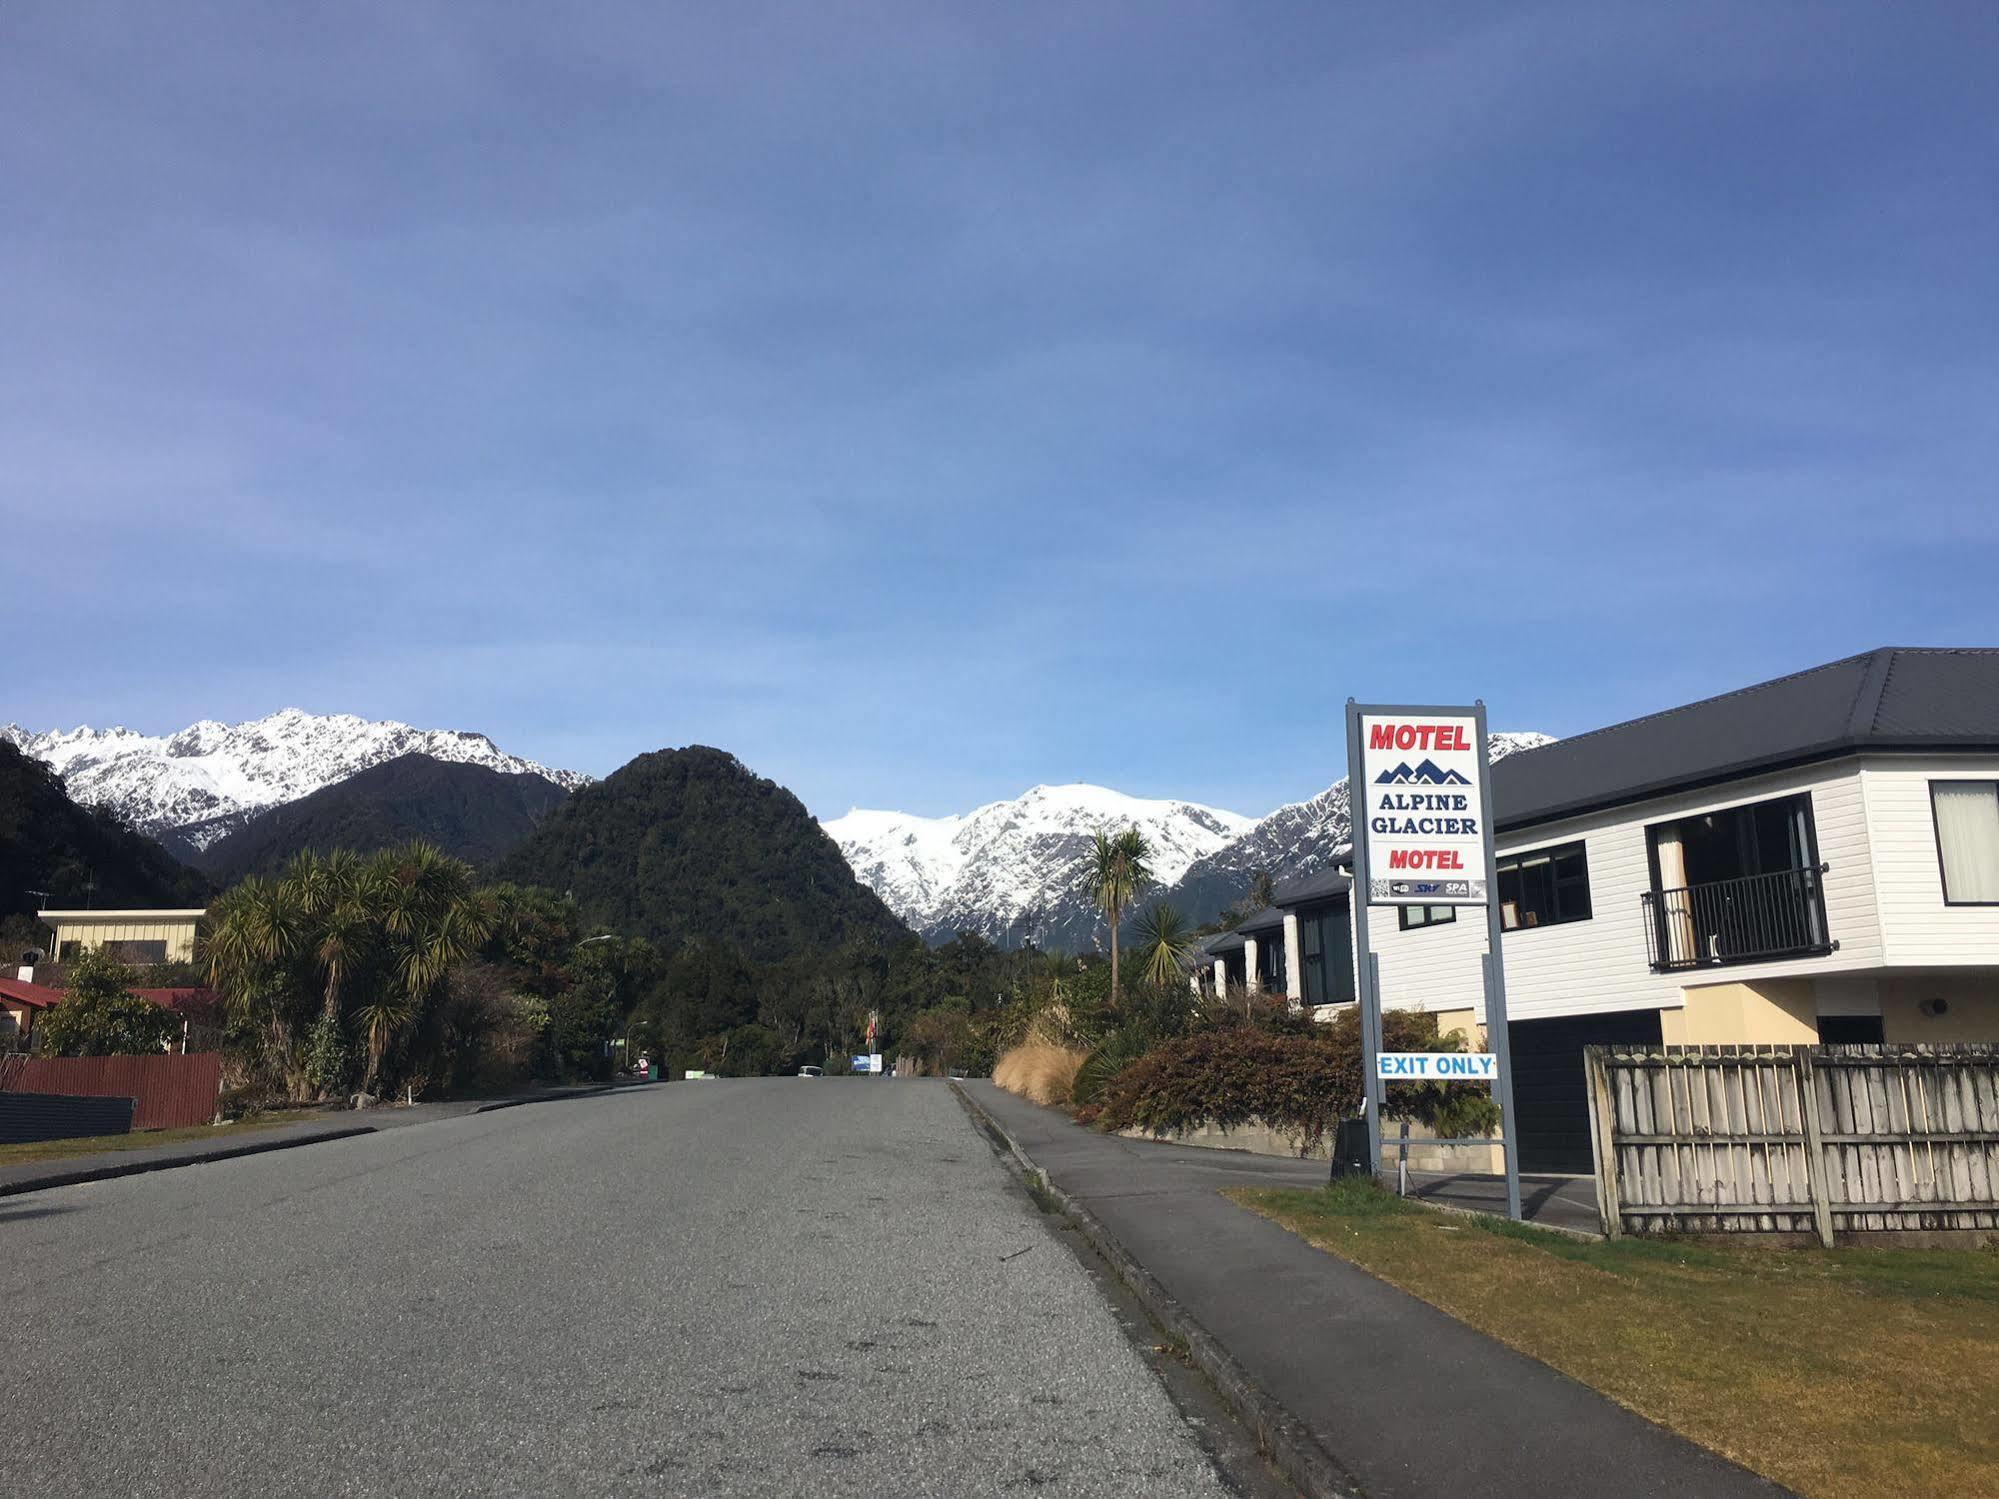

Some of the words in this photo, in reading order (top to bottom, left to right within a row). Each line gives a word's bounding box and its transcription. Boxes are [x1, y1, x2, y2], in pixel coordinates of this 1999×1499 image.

[1370, 725, 1470, 751] MOTEL
[1379, 794, 1468, 810] ALPINE
[1371, 818, 1478, 834] GLACIER
[1389, 850, 1464, 870] MOTEL
[1414, 884, 1440, 893] SKY
[1445, 882, 1468, 892] SPA
[1380, 1057, 1428, 1074] EXIT
[1436, 1057, 1492, 1074] ONLY
